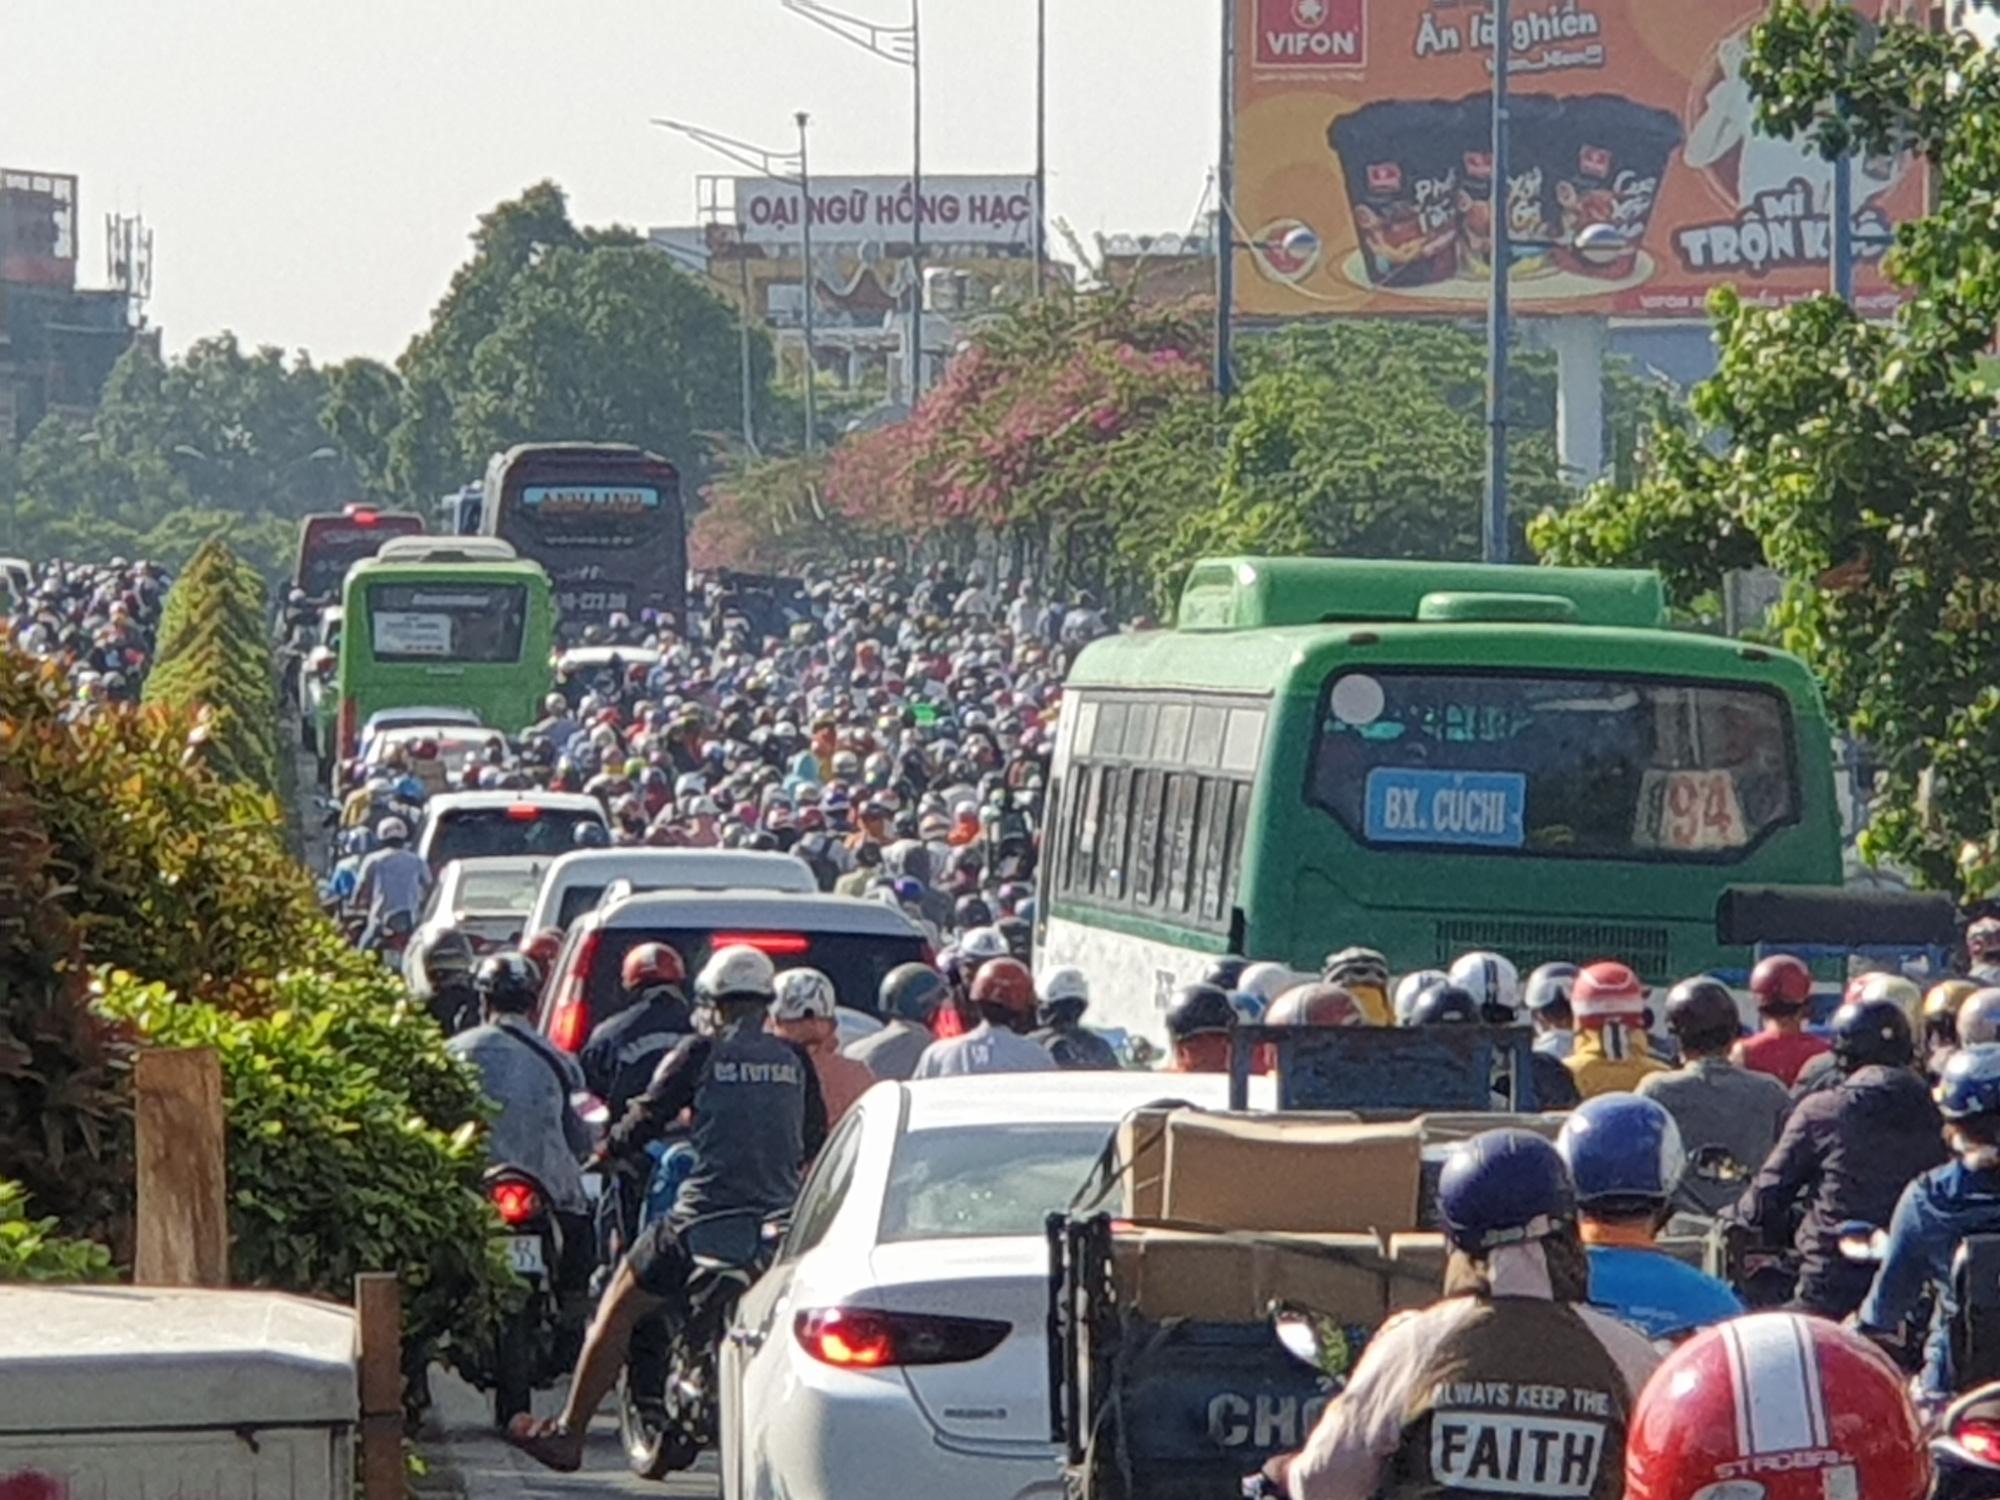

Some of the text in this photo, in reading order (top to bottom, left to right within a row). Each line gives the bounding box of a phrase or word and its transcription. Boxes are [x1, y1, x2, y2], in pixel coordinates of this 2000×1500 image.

[1266, 31, 1355, 55] VIFON
[1416, 13, 1459, 55] Ăn
[1679, 210, 1888, 270] TRỘN KÔ
[1385, 786, 1428, 829] BX.
[1668, 774, 1733, 847] 94
[1515, 1384, 1568, 1410] KEEP
[1572, 1387, 1611, 1415] THE
[1441, 1424, 1596, 1486] FAITH
